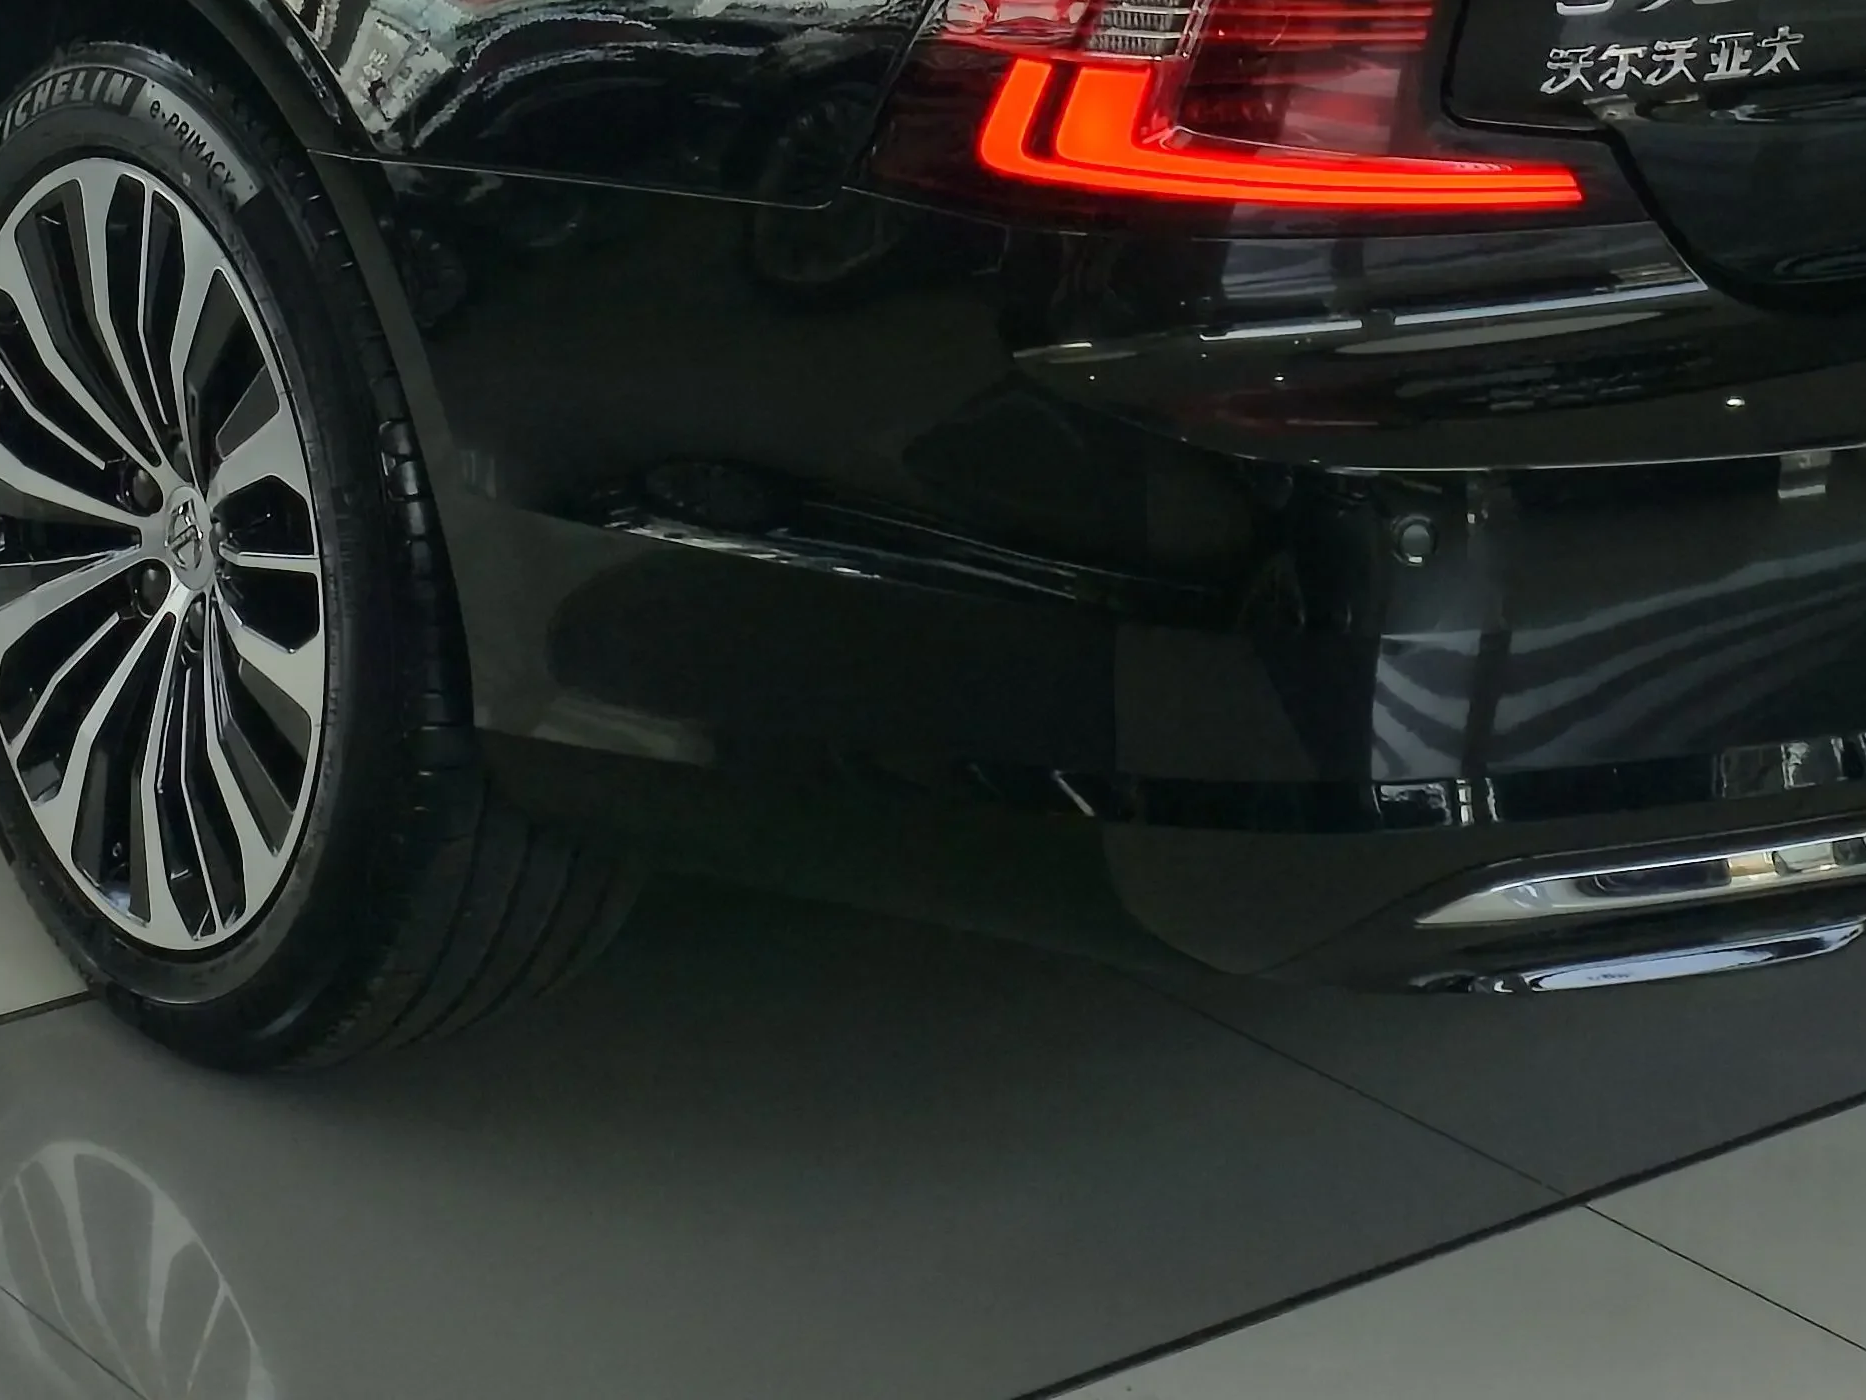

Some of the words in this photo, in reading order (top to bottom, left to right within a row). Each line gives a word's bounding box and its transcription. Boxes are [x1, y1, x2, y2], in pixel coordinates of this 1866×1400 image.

[1540, 25, 1804, 94] 沃尔沃亚太
